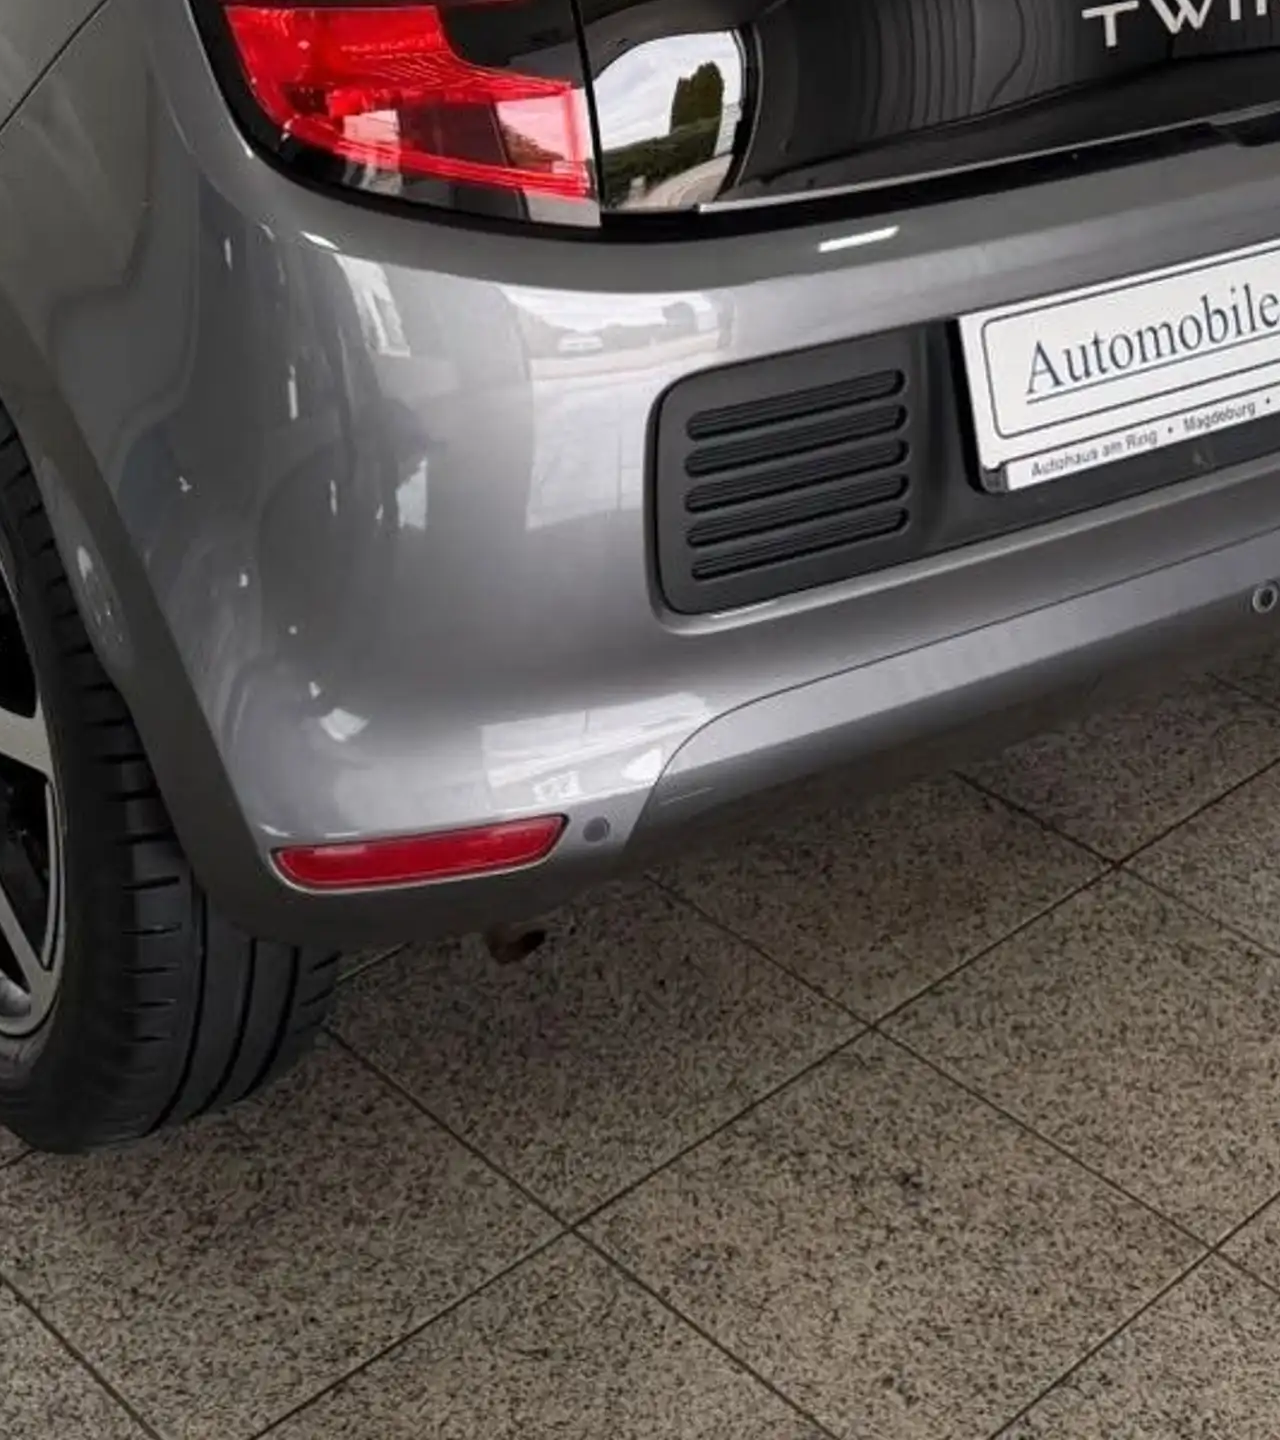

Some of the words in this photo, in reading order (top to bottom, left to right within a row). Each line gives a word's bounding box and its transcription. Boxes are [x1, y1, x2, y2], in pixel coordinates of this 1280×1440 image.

[1030, 447, 1099, 477] Autohaus
[1102, 440, 1123, 458] am
[1125, 429, 1158, 450] Ring
[1182, 400, 1257, 433] Magdeburg
